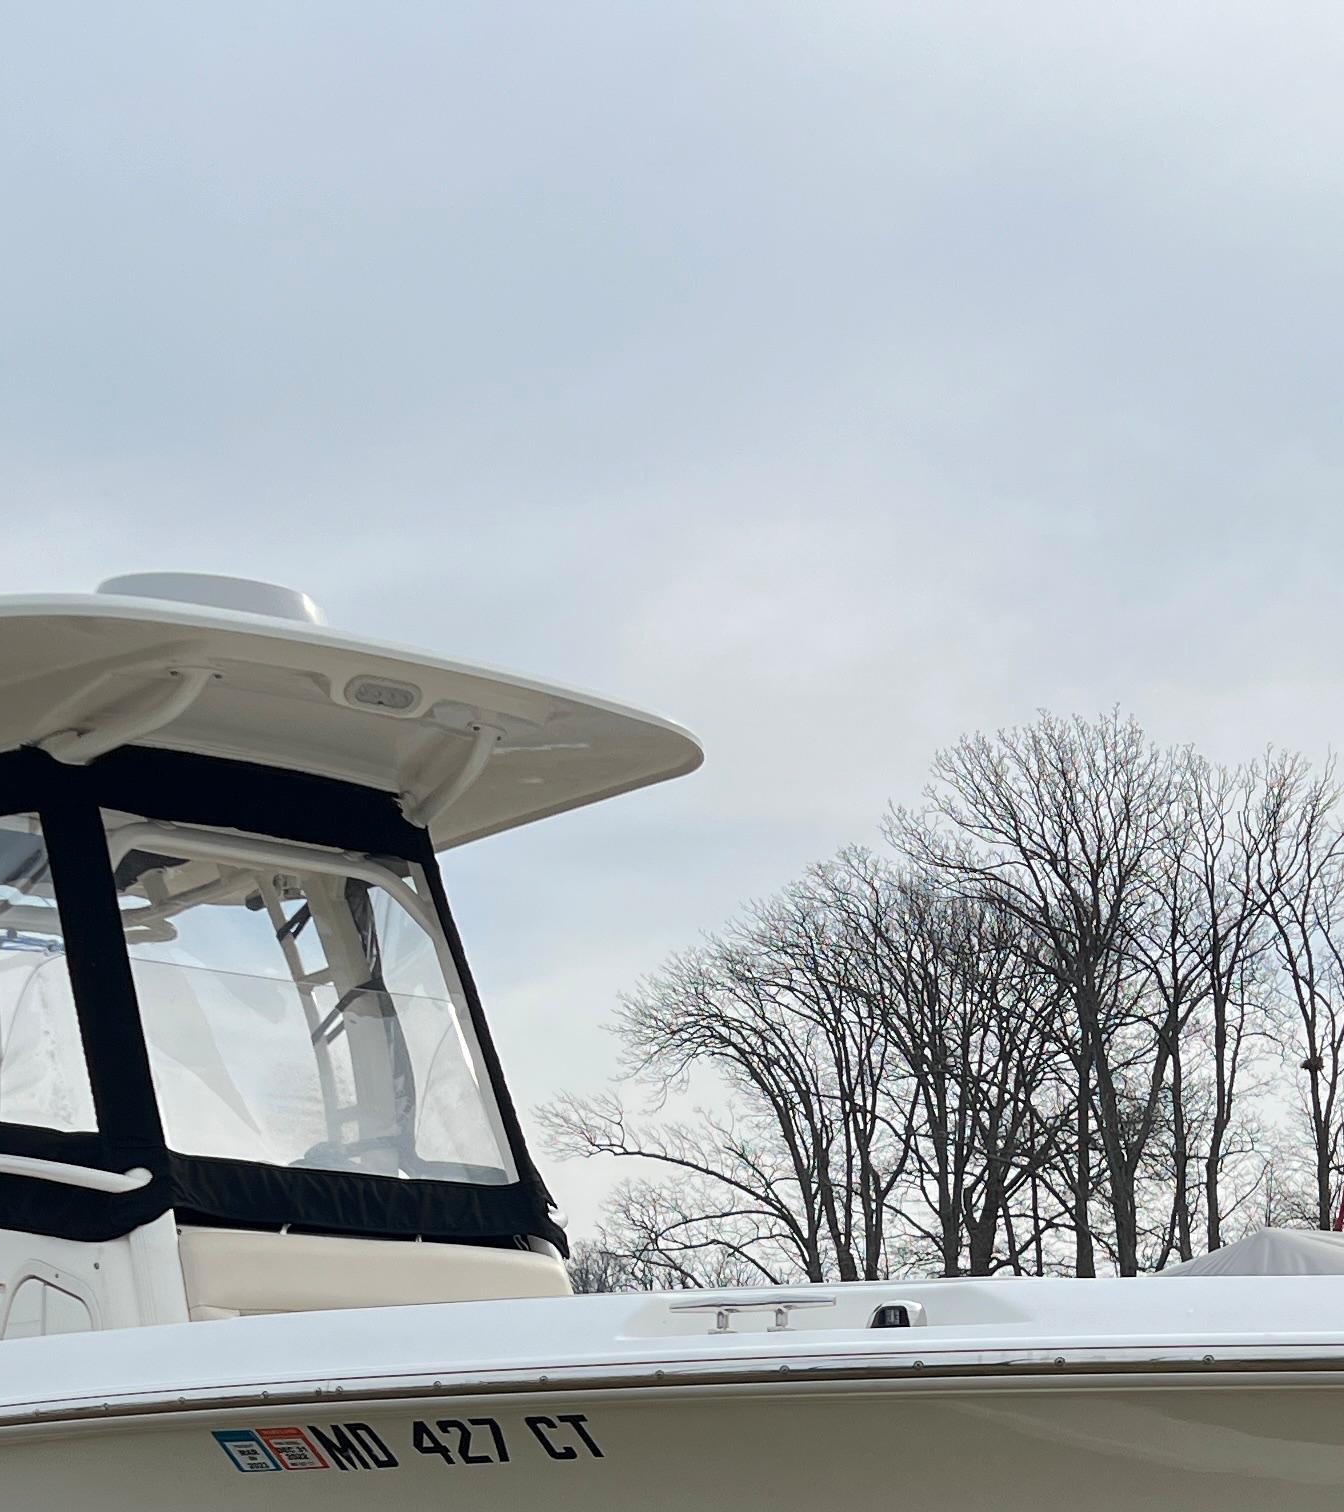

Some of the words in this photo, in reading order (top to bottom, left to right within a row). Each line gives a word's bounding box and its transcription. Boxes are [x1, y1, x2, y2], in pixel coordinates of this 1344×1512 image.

[307, 1423, 400, 1471] MD
[412, 1418, 511, 1465] 427
[524, 1414, 605, 1460] CT
